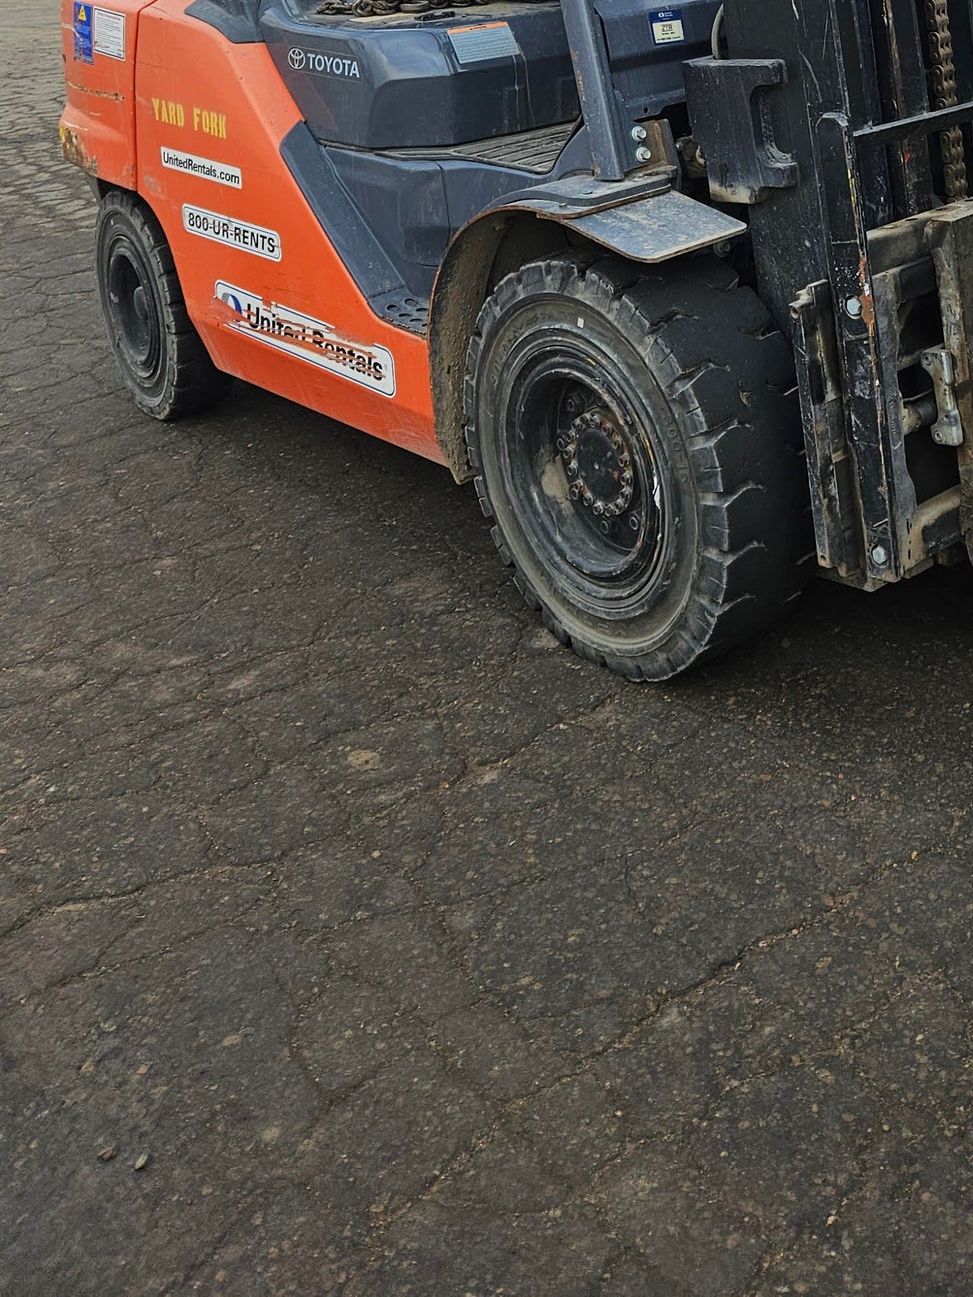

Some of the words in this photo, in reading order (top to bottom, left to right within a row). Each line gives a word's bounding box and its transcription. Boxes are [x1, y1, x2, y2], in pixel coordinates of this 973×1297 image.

[307, 53, 360, 78] TOYOTA
[152, 97, 184, 127] YARD
[193, 107, 226, 139] FORK
[163, 152, 240, 184] UnitedRentals.com
[188, 212, 275, 253] 800-UR-RENTS
